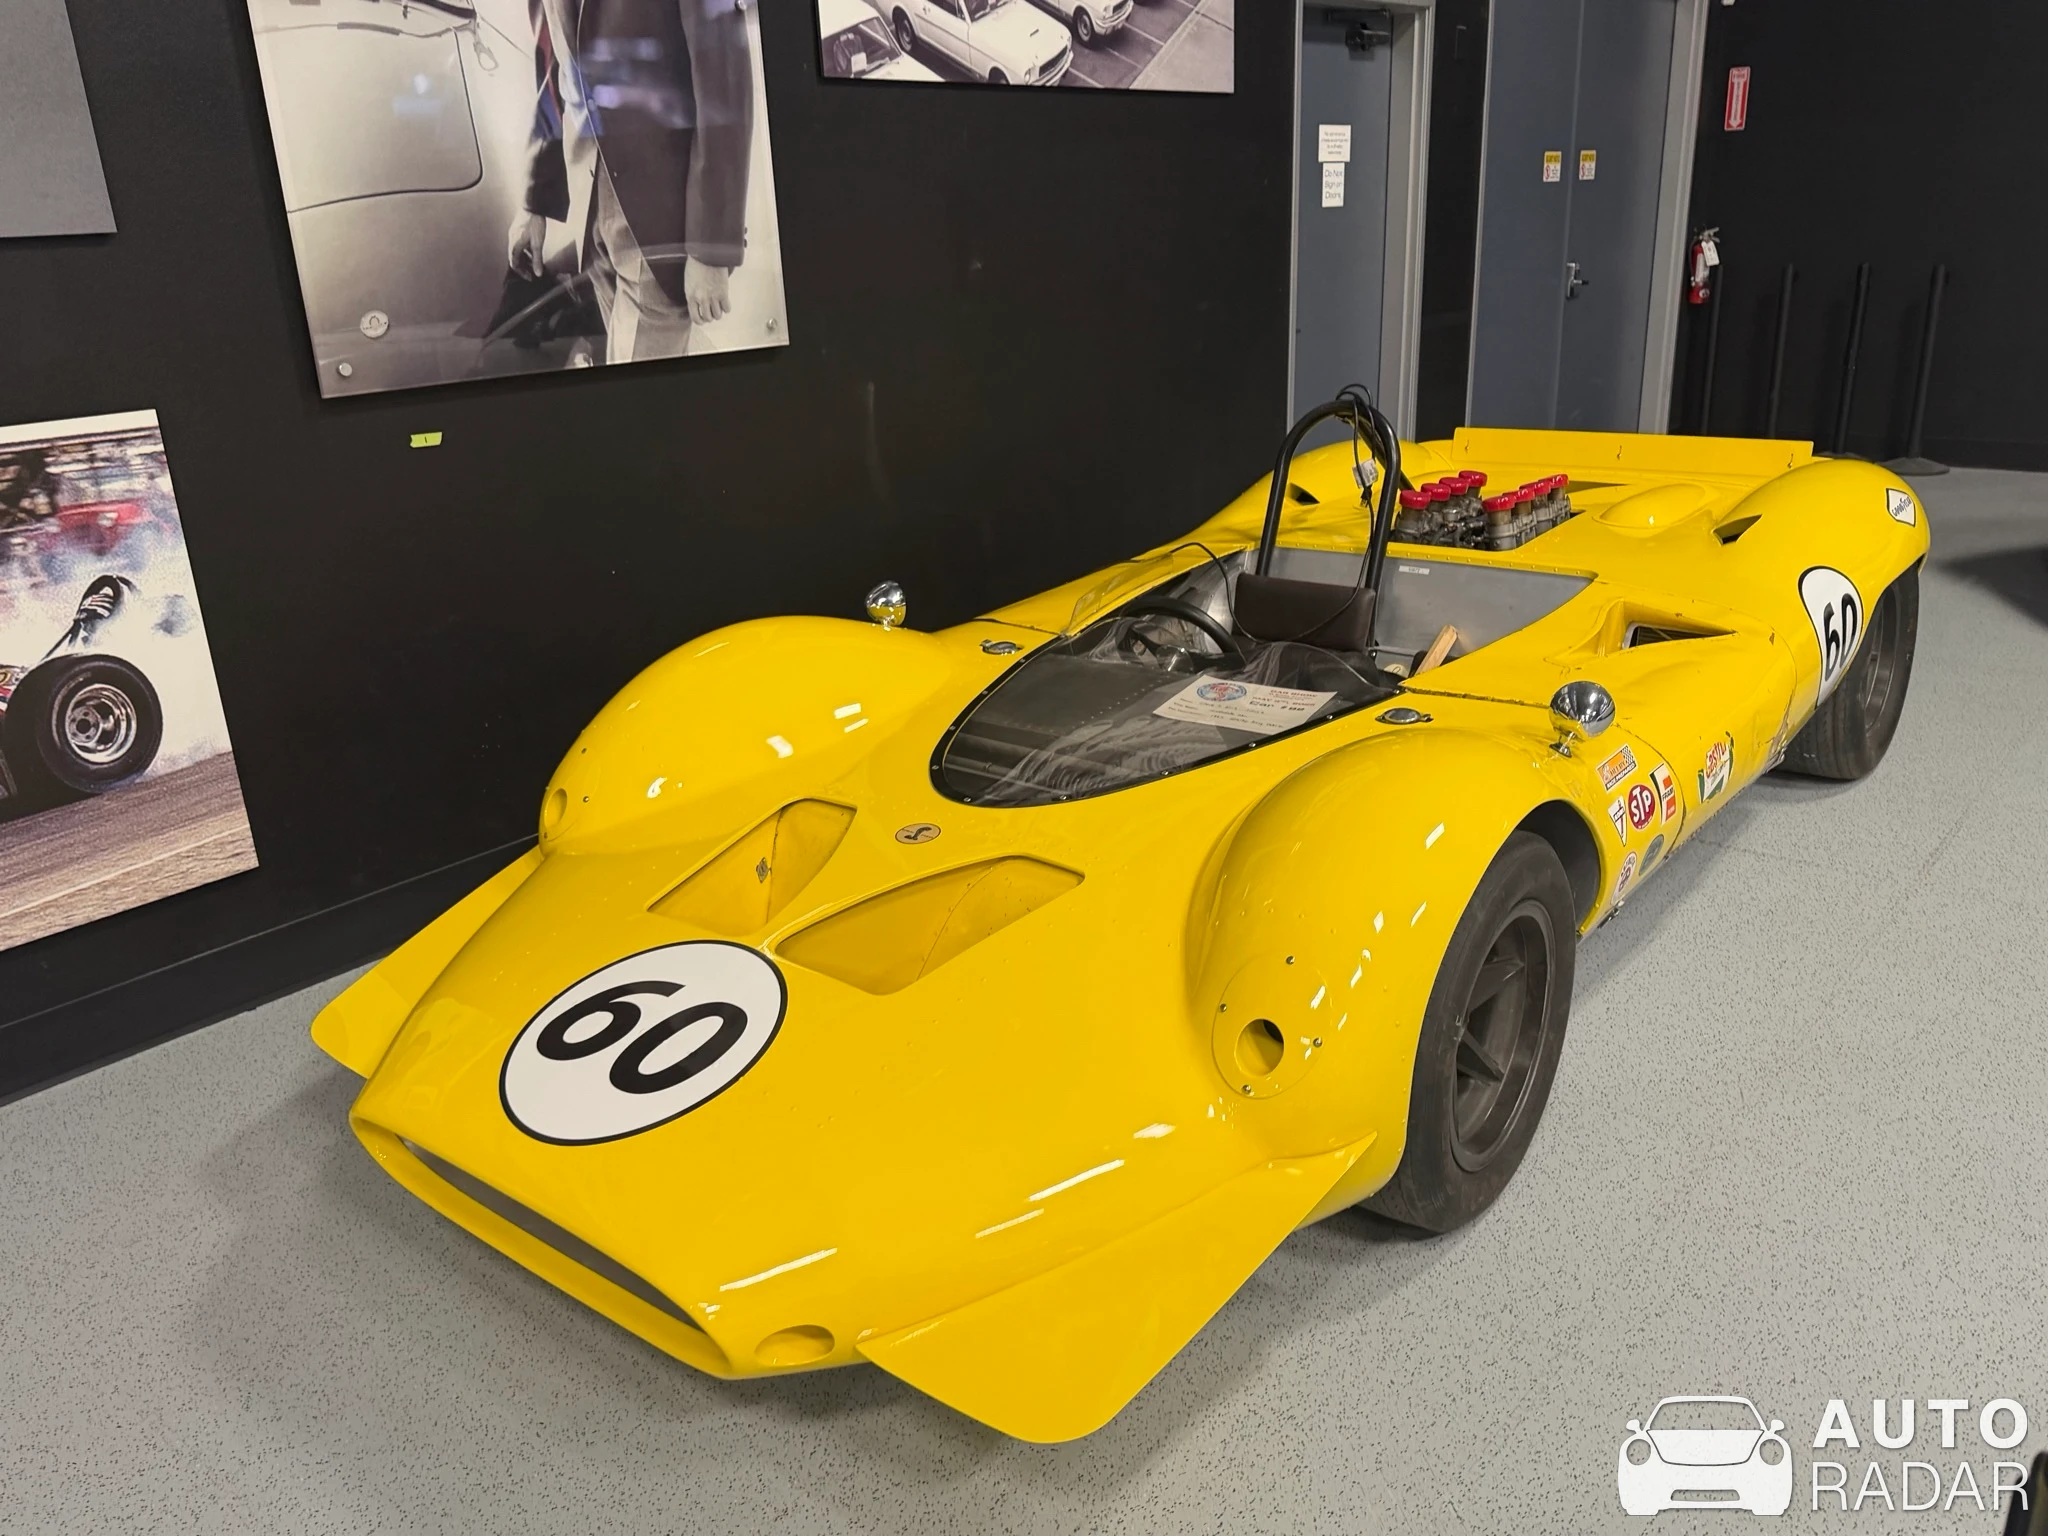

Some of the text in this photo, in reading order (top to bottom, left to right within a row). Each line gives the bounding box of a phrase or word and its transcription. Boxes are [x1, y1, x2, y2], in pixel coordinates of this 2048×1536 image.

[1823, 593, 1858, 682] 60
[1631, 786, 1652, 823] STP
[536, 980, 749, 1095] 60
